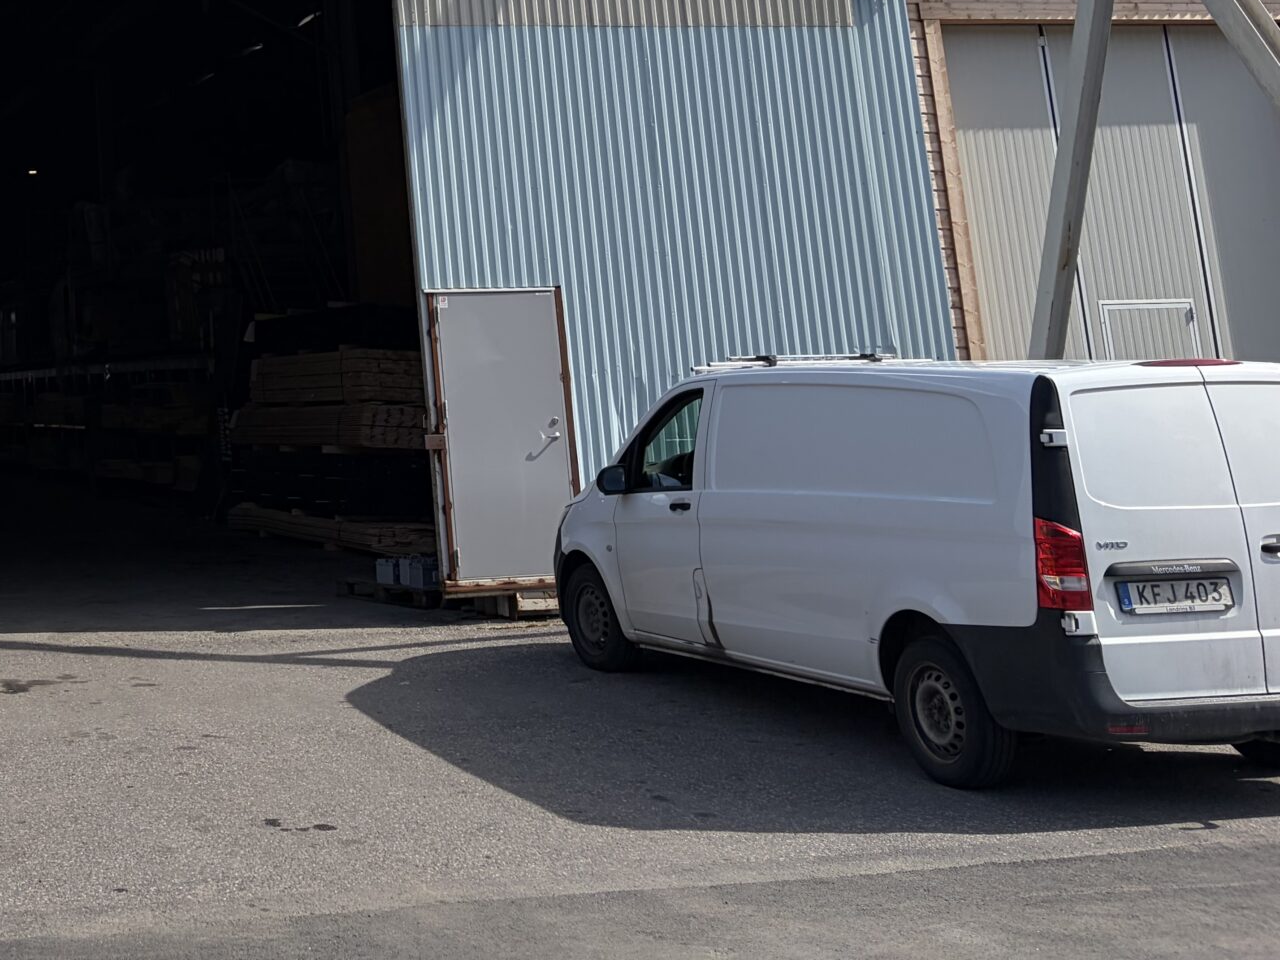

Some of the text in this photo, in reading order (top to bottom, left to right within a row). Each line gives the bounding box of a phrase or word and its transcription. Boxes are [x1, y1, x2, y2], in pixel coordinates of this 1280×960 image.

[1151, 564, 1202, 575] Mercedes-Benz
[1136, 581, 1223, 606] KFJ 403
